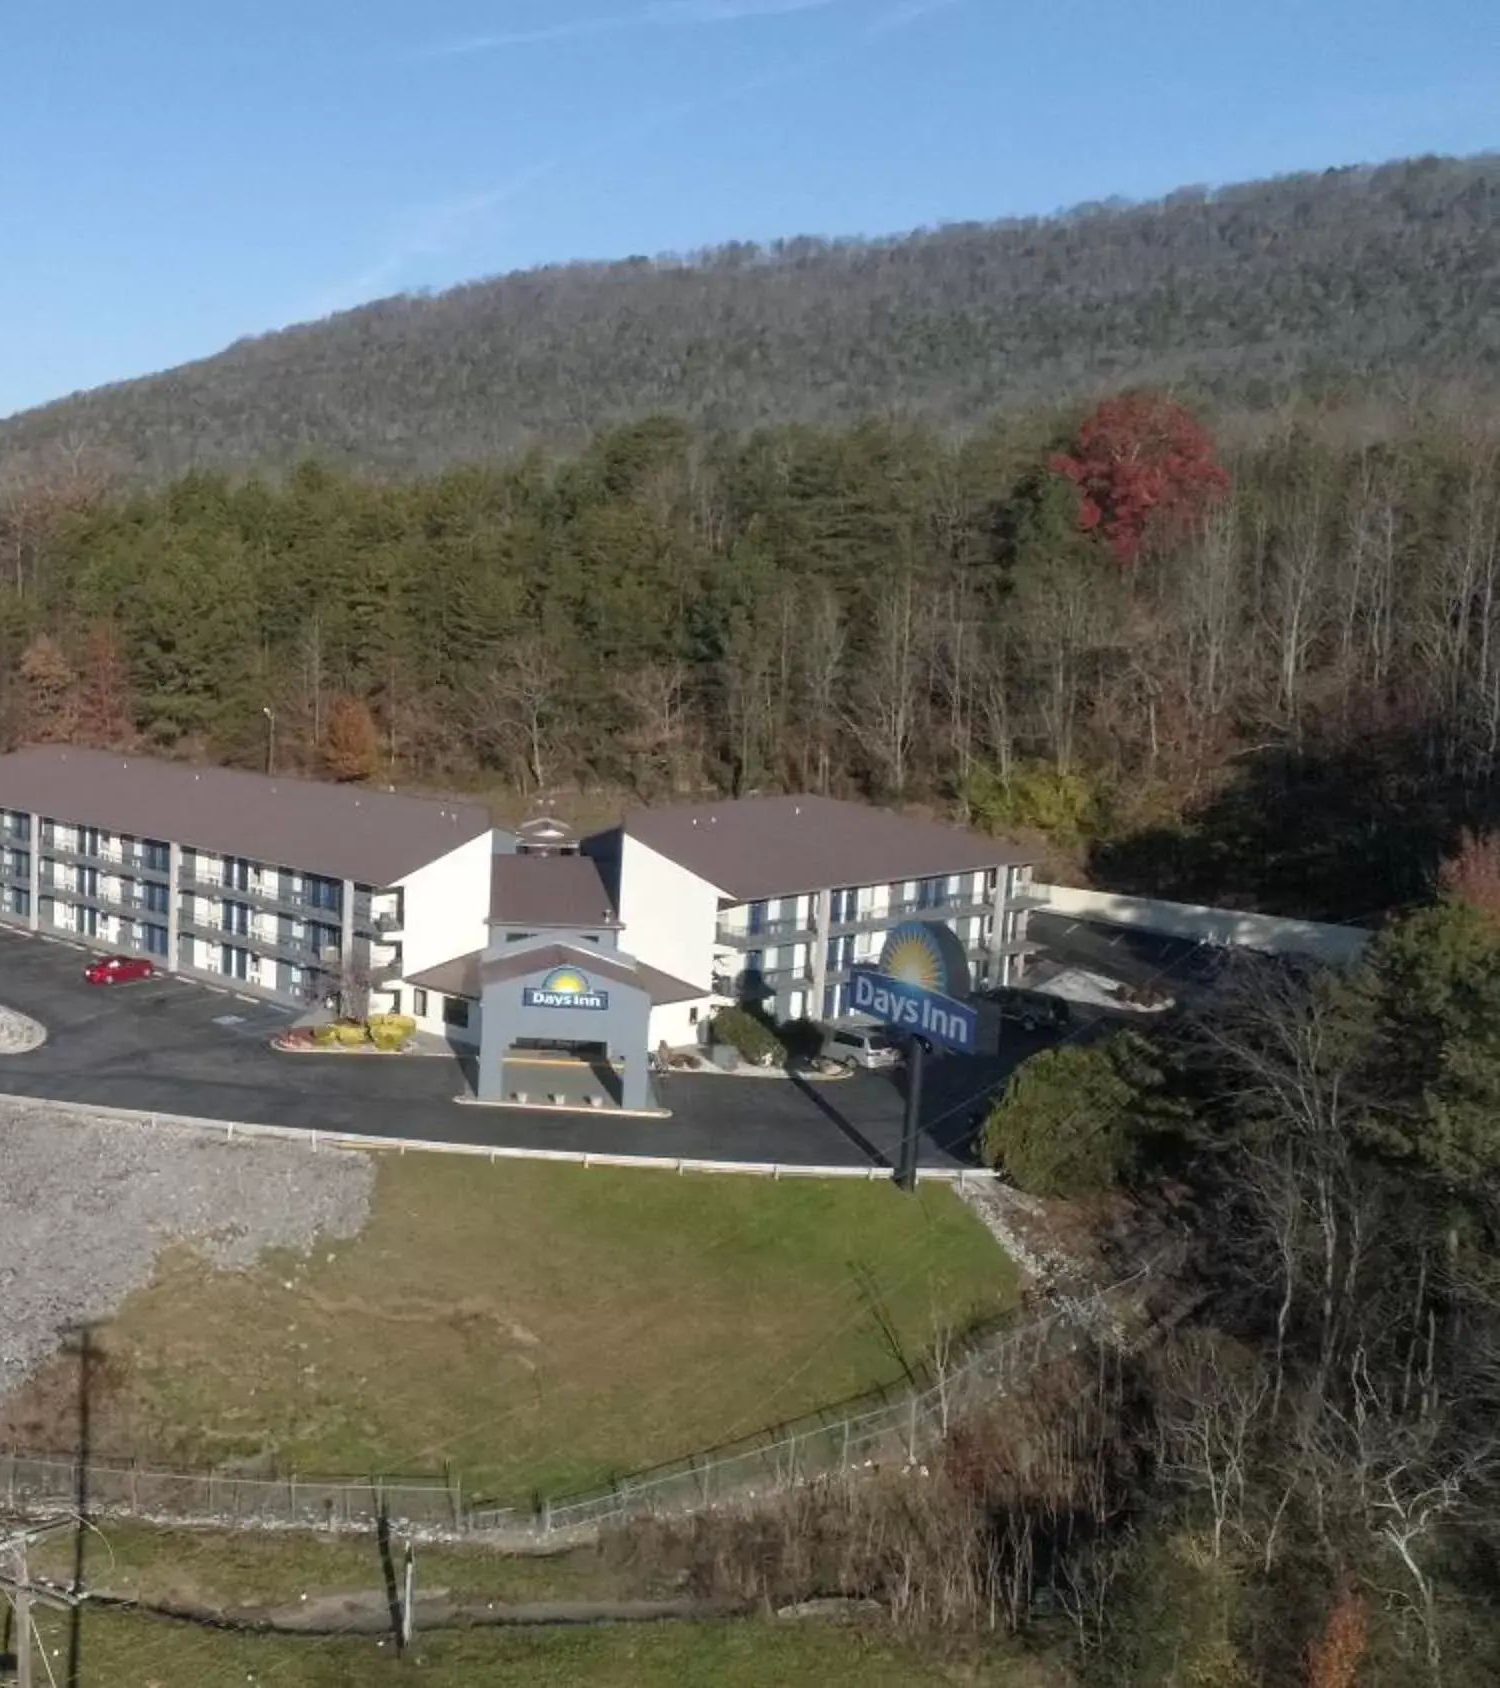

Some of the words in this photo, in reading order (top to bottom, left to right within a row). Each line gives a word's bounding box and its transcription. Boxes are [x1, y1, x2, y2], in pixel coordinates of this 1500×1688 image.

[532, 991, 571, 1007] Days
[574, 994, 601, 1007] Inn
[854, 975, 919, 1024] Days
[922, 999, 968, 1044] Inn
